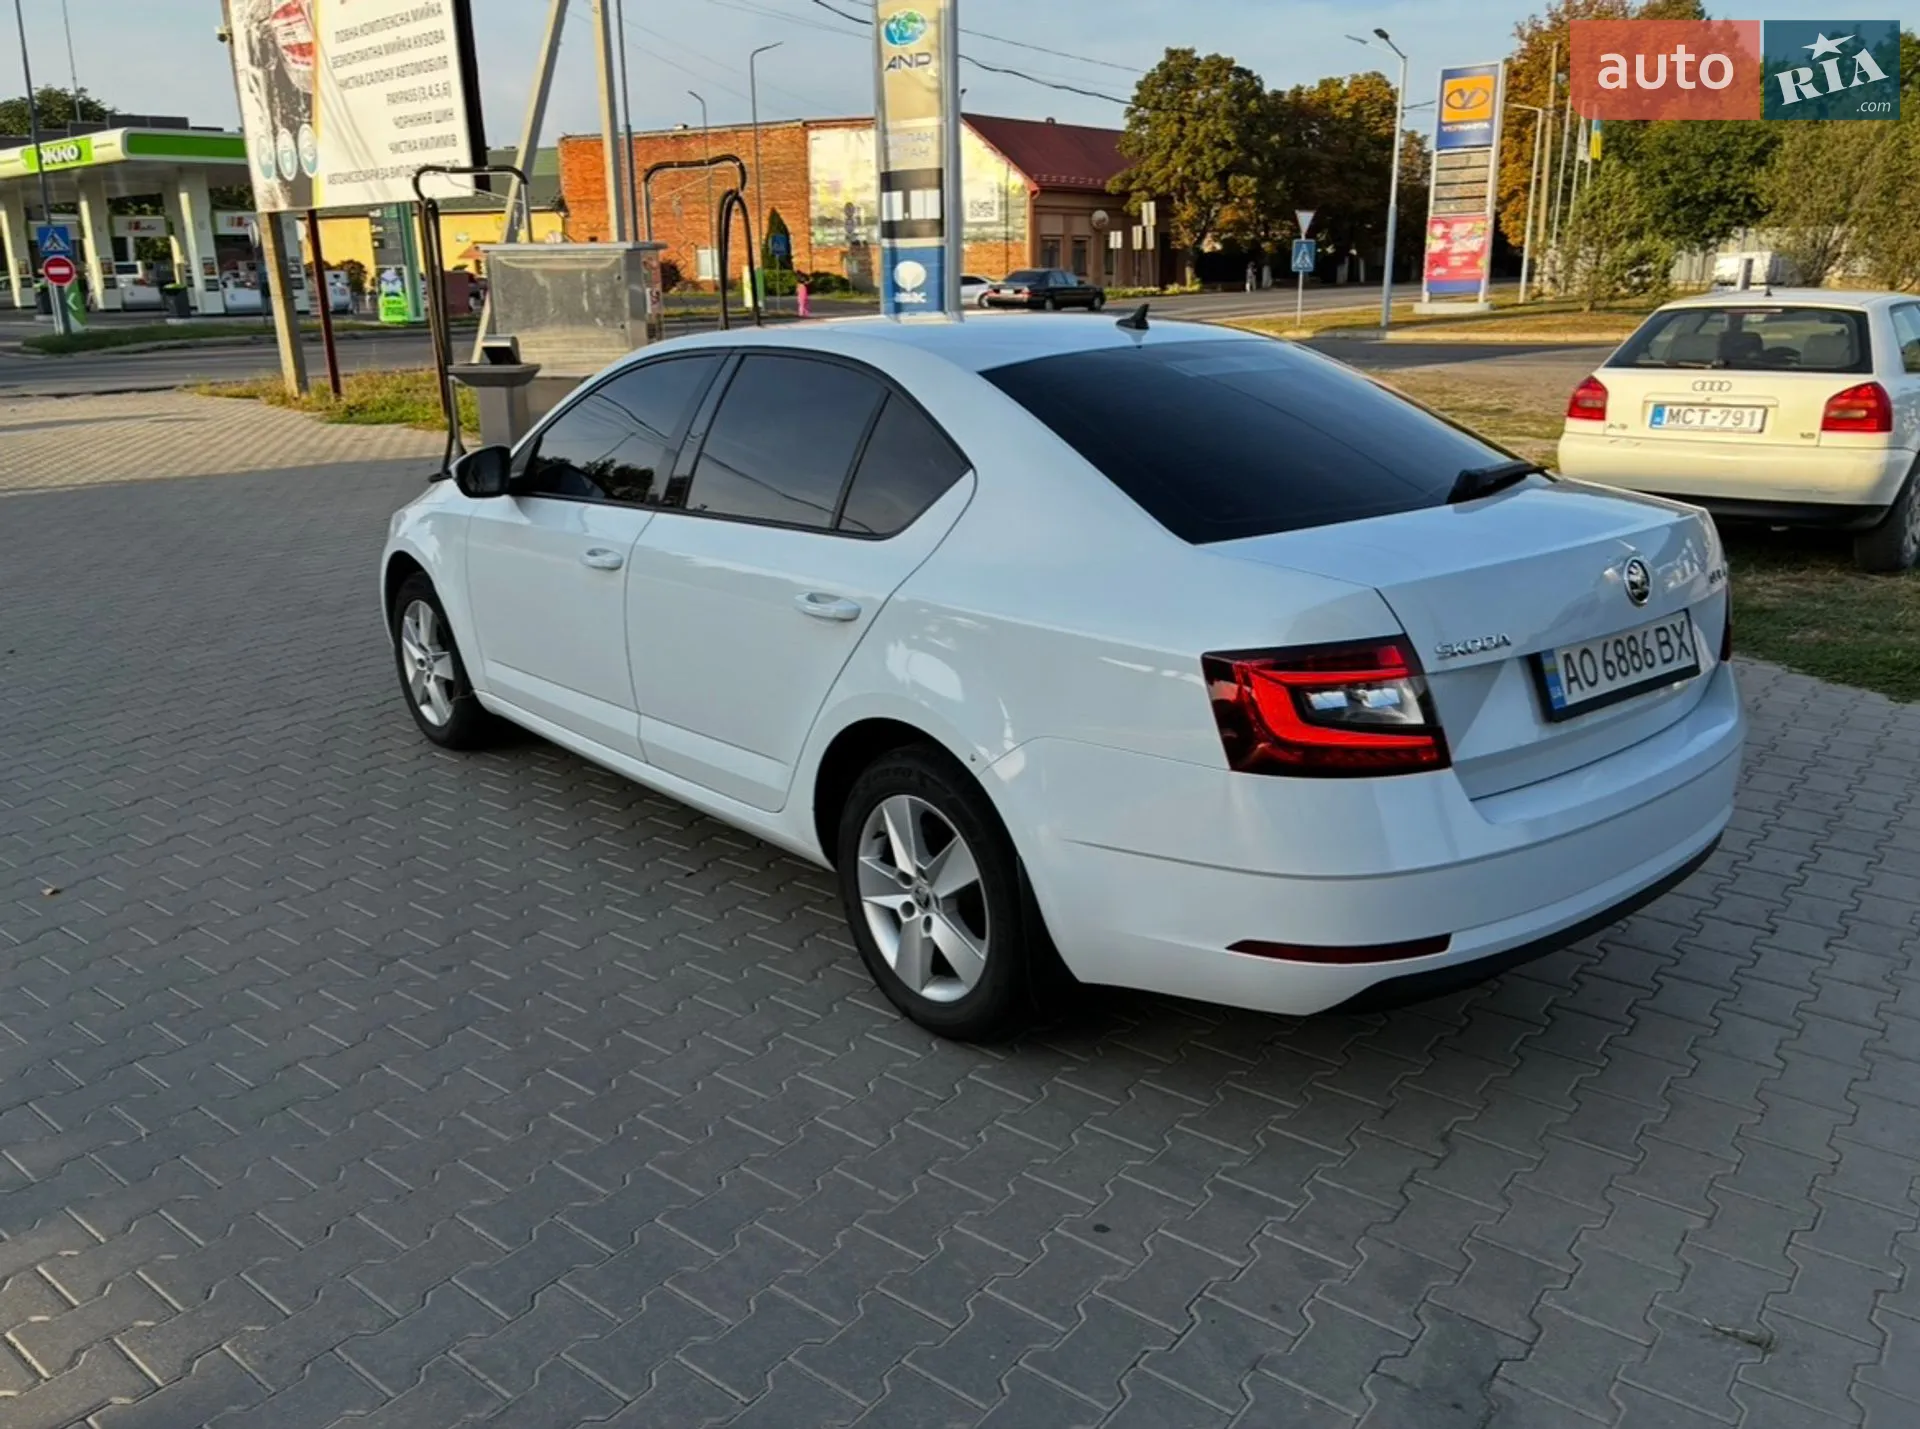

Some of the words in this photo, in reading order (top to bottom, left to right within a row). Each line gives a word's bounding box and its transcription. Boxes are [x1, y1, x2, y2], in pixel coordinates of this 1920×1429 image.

[1666, 407, 1757, 429] MCT-791
[1562, 647, 1599, 695] AO
[1602, 631, 1657, 682] 6886
[1656, 620, 1692, 665] BX
